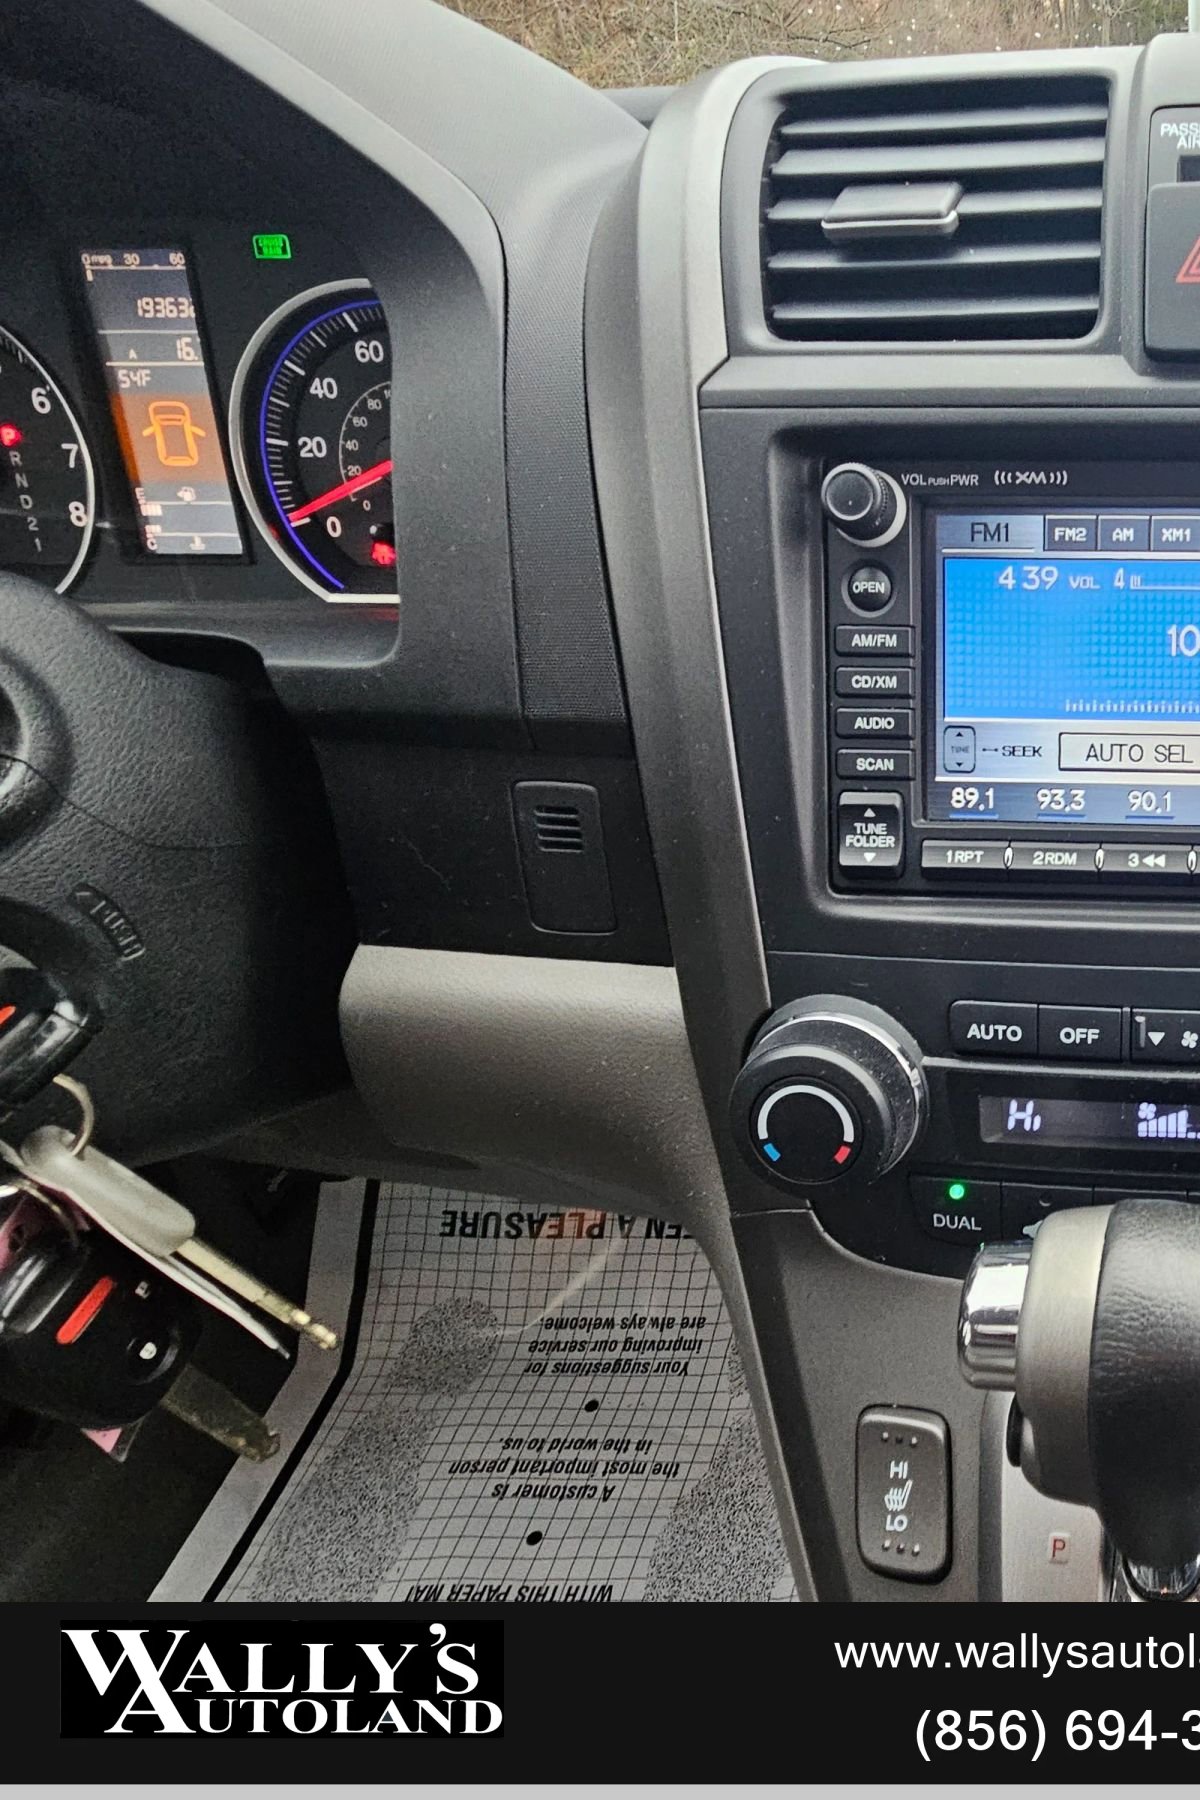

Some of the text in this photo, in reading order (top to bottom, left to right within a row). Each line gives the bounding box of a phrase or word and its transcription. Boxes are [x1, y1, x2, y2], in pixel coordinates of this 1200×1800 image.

[123, 253, 140, 265] 30
[169, 252, 186, 265] 60
[355, 341, 384, 363] 60
[309, 378, 338, 400] 40
[31, 387, 51, 414] 6
[367, 398, 383, 411] 80
[352, 416, 368, 428] 60
[299, 436, 327, 458] 20
[345, 439, 359, 451] 40
[9, 450, 22, 466] R
[61, 443, 78, 469] 7
[15, 473, 29, 488] N
[901, 473, 927, 486] VOL
[951, 474, 979, 486] PWR
[19, 494, 33, 510] D
[69, 501, 88, 528] 8
[27, 516, 39, 531] 2
[326, 516, 342, 538] 0
[971, 522, 1010, 543] FM1
[1054, 527, 1087, 542] FM2
[1112, 528, 1134, 542] AM
[1161, 528, 1192, 542] XM1
[852, 581, 885, 593] OPEN
[1069, 575, 1099, 589] VOL
[852, 634, 897, 647] AM/FM
[852, 676, 897, 689] CD/XM
[854, 717, 895, 730] AUDIO
[1002, 745, 1042, 757] SEEK
[1085, 745, 1144, 762] AUTO
[1154, 745, 1194, 763] SEL
[856, 758, 894, 771] SCAN
[854, 823, 888, 836] TUNE
[845, 835, 895, 849] FOLDER
[1128, 854, 1139, 867] 3
[967, 1024, 1022, 1042] AUTO
[1059, 1026, 1100, 1044] OFF
[440, 1209, 606, 1239] PLEASURE
[933, 1213, 982, 1231] DUAL
[620, 1314, 677, 1332] always
[680, 1317, 706, 1329] are
[529, 1336, 703, 1356] improving our service
[524, 1358, 690, 1376] Your suggestions for
[526, 1438, 546, 1452] to
[550, 1437, 600, 1453] world
[601, 1438, 631, 1453] the
[635, 1438, 652, 1453] in
[448, 1458, 680, 1477] the most important person
[890, 1460, 908, 1479] HI
[491, 1485, 616, 1502] A customer is
[886, 1514, 908, 1532] LO
[1051, 1538, 1066, 1559] P
[447, 1584, 513, 1603] PAPER
[515, 1584, 560, 1603] THIS
[563, 1584, 614, 1603] WITH
